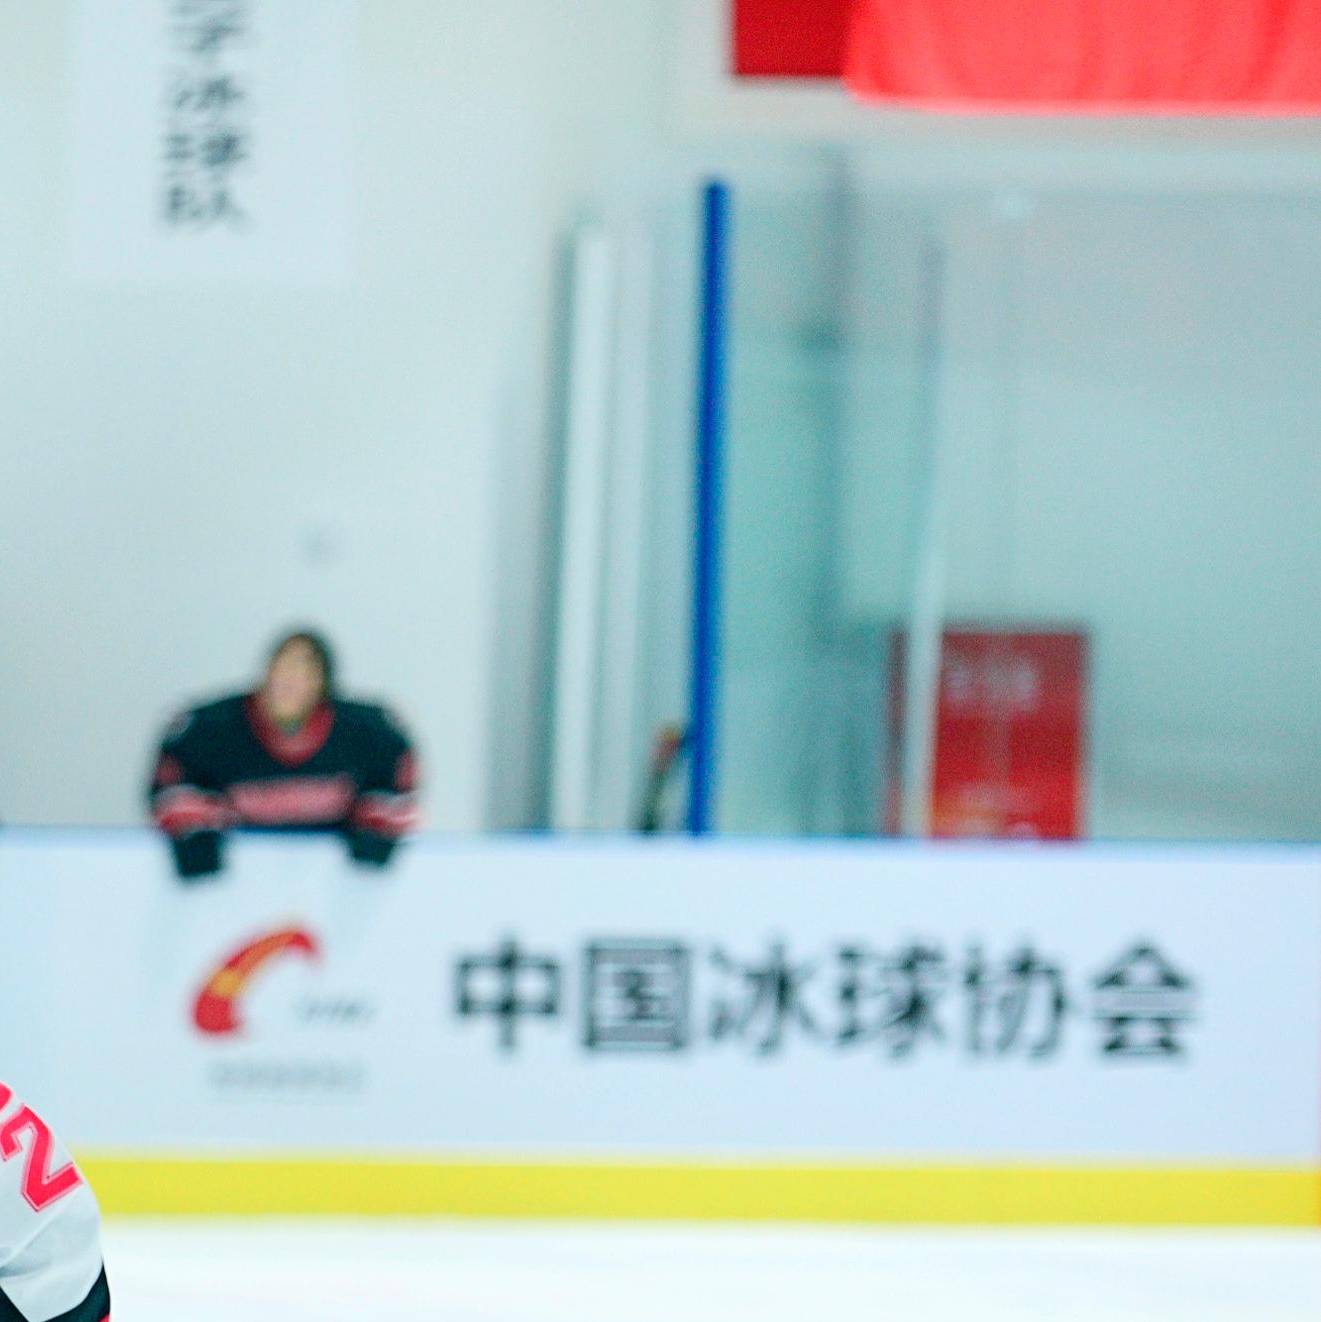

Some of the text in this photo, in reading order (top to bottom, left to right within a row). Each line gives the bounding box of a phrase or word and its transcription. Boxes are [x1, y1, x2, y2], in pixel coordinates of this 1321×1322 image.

[452, 938, 1198, 1060] 中国冰球协会
